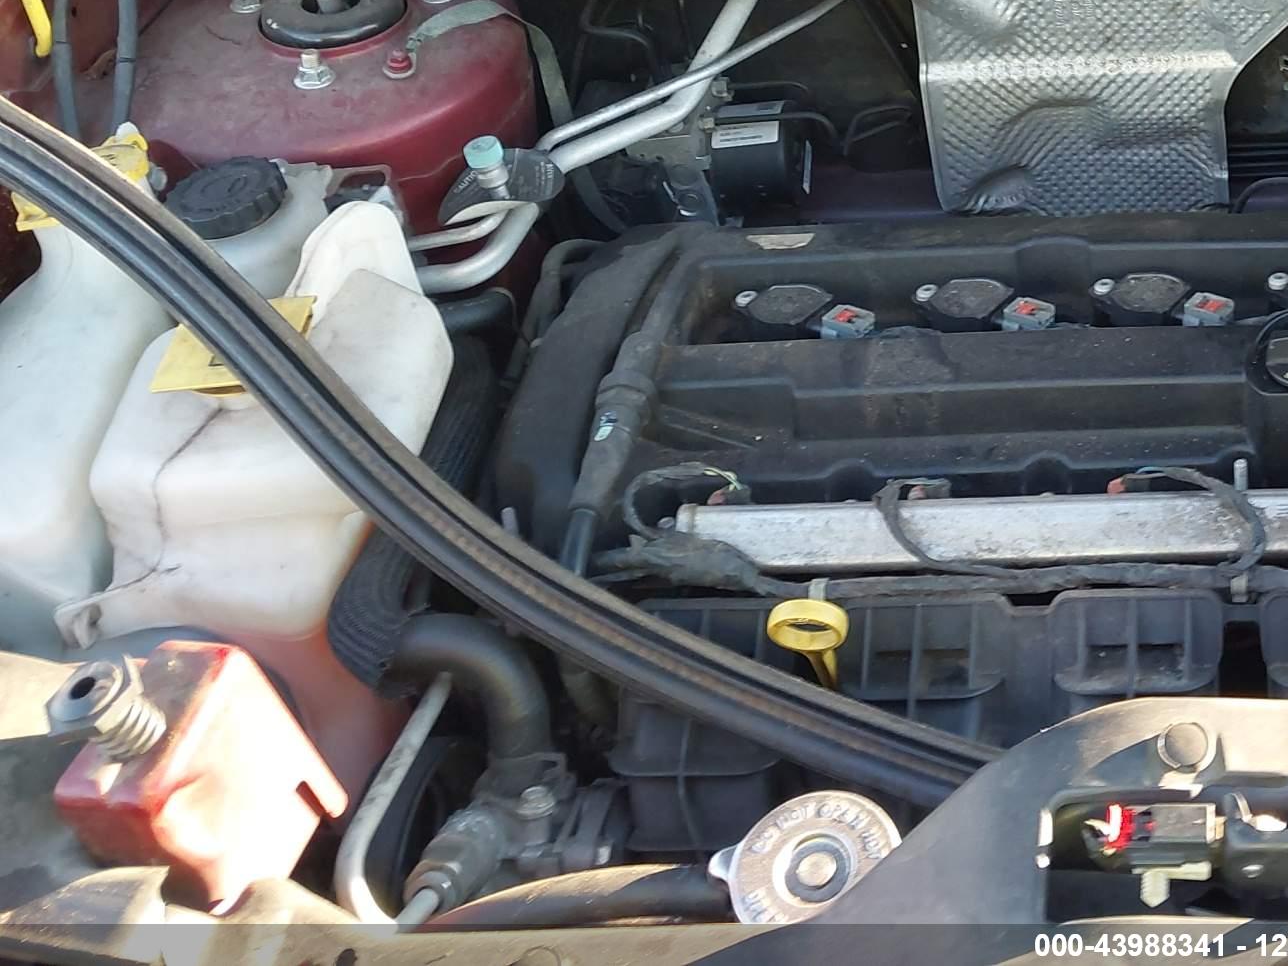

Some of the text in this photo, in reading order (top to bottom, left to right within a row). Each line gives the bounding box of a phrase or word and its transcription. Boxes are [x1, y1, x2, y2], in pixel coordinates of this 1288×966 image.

[452, 170, 479, 194] CAUTIO
[776, 802, 817, 829] NOT
[816, 801, 870, 831] OPEN
